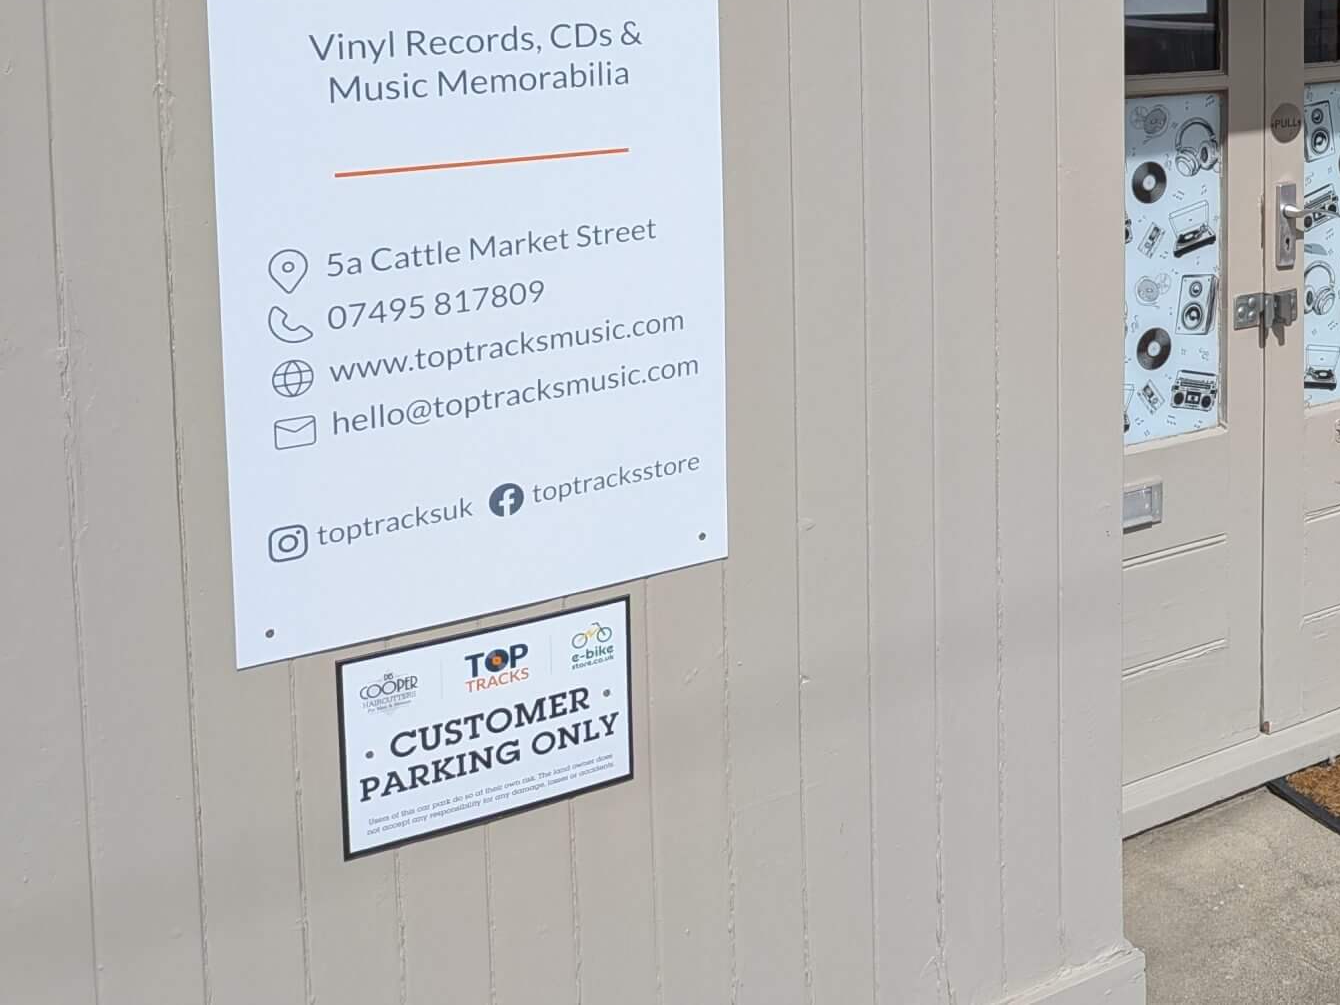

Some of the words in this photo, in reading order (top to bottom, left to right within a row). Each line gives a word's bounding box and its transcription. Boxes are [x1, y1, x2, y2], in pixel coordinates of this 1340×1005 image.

[308, 30, 395, 64] Vinyl
[406, 25, 542, 58] Records,
[549, 23, 612, 51] CDs
[620, 21, 642, 47] &
[329, 71, 428, 103] Music
[438, 61, 630, 97] Memorabilia
[1274, 117, 1297, 130] PULL
[326, 252, 362, 277] 5a
[370, 242, 461, 272] Cattle
[469, 228, 568, 261] Market
[576, 218, 657, 246] Street
[327, 295, 425, 330] 07495
[434, 280, 545, 316] 817809
[329, 311, 685, 383] www.toptracksmusic.com
[333, 359, 699, 435] hello@toptracksmusic.com
[532, 454, 701, 507] toptracksstore
[317, 497, 473, 547] toptracksuk
[464, 643, 529, 678] TOP
[571, 645, 614, 663] e-bike
[360, 675, 418, 700] COOPER
[465, 667, 529, 693] TRACKS
[390, 687, 590, 758] CUSTOMER
[360, 739, 521, 802] PARKING
[531, 712, 620, 756] ONLY
